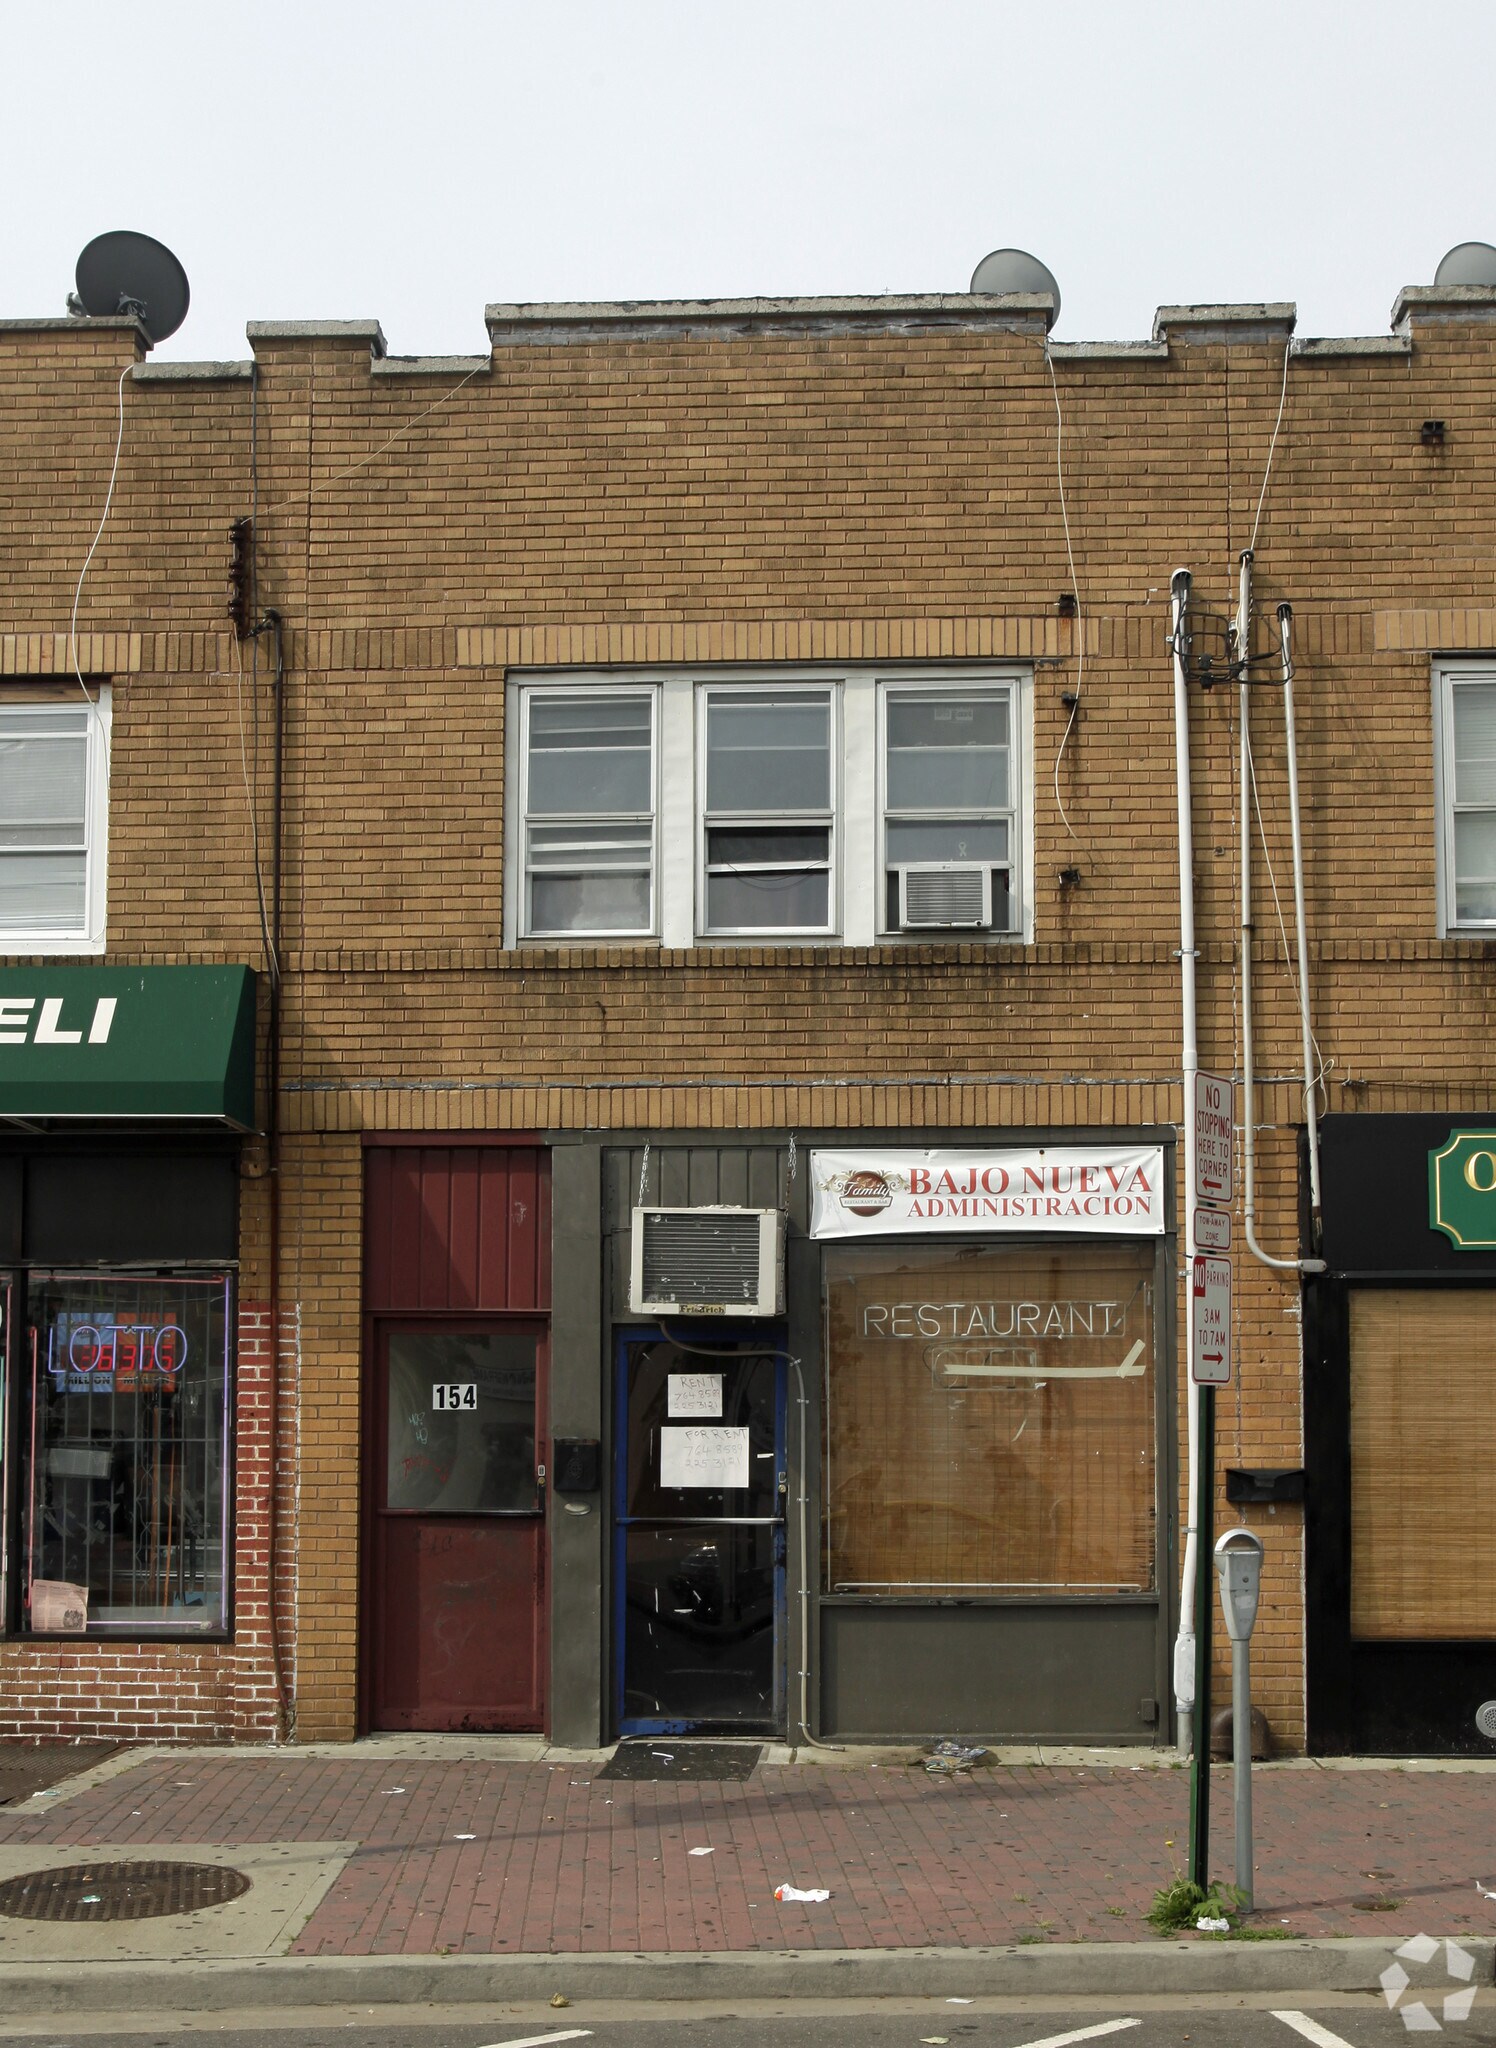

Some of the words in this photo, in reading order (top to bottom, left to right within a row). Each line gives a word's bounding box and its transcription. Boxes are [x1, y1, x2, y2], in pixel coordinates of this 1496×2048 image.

[1205, 1085, 1221, 1109] NO
[1197, 1110, 1230, 1139] STOPPING
[1197, 1137, 1216, 1157] HERE
[1219, 1141, 1229, 1159] TO
[1199, 1158, 1228, 1179] CORNER
[907, 1166, 1010, 1196] BAJO
[1021, 1164, 1153, 1194] NUEVA
[841, 1181, 891, 1199] Family
[907, 1195, 1153, 1218] ADMINISTRACION
[1199, 1215, 1226, 1228] TOW-AWAY
[1205, 1231, 1220, 1242] ZONE
[1194, 1263, 1205, 1288] NO
[1206, 1269, 1229, 1288] PARKING
[680, 1303, 725, 1314] Friedrich
[1203, 1307, 1221, 1325] 3AM
[863, 1302, 1119, 1337] RESTAURANT
[1199, 1329, 1208, 1346] TO
[1210, 1330, 1226, 1347] 7AM
[47, 1325, 188, 1374] LOTTO
[66, 1376, 111, 1385] MILLON
[679, 1375, 716, 1390] RENT
[436, 1385, 475, 1409] 154
[674, 1392, 696, 1402] 764
[685, 1429, 710, 1441] FOR
[712, 1428, 747, 1440] RENT
[683, 1444, 711, 1456] 764
[684, 1458, 710, 1469] 225
